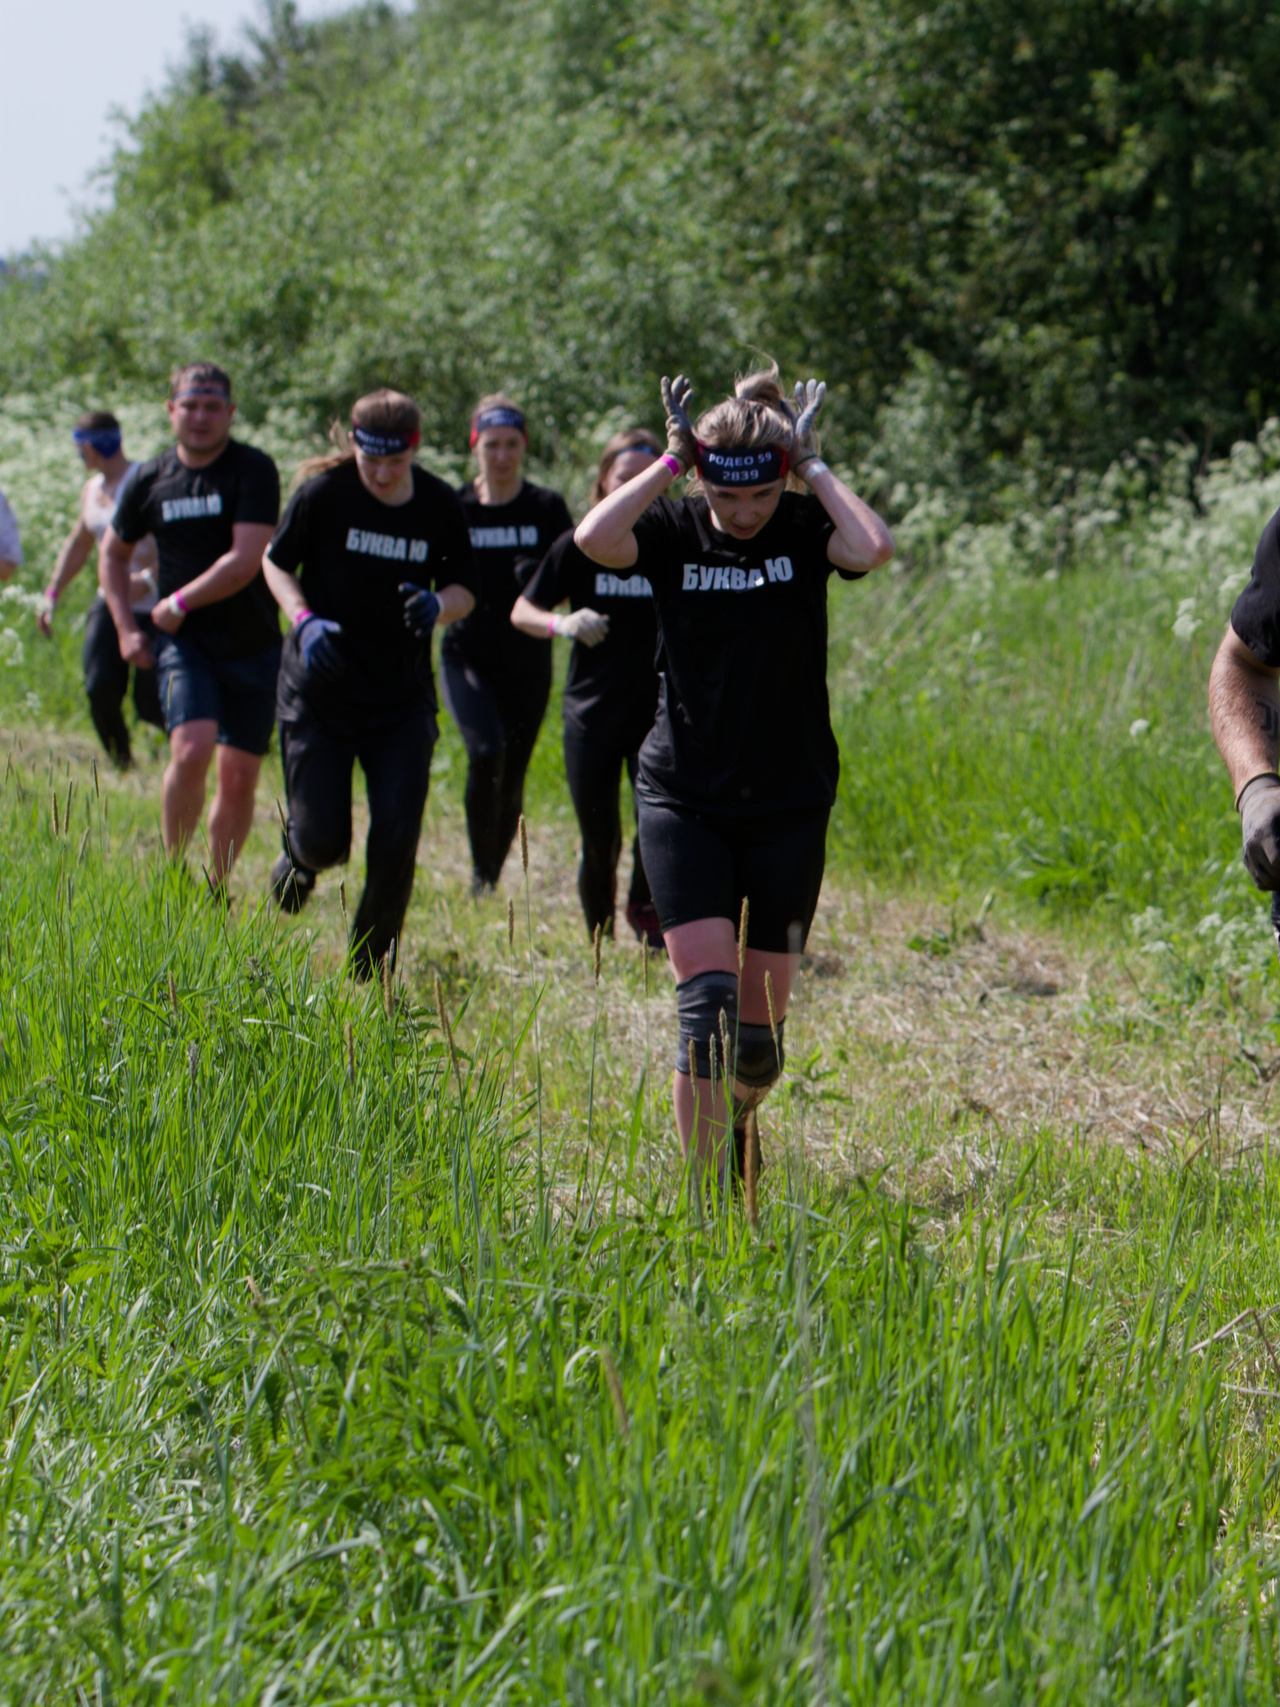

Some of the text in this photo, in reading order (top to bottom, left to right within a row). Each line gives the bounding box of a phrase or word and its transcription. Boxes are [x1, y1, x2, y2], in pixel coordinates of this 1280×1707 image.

[708, 452, 772, 468] РОДЕО 59
[722, 469, 760, 482] 2839
[345, 526, 429, 564] БУКВА Ю
[682, 556, 793, 591] БУКВА Ю
